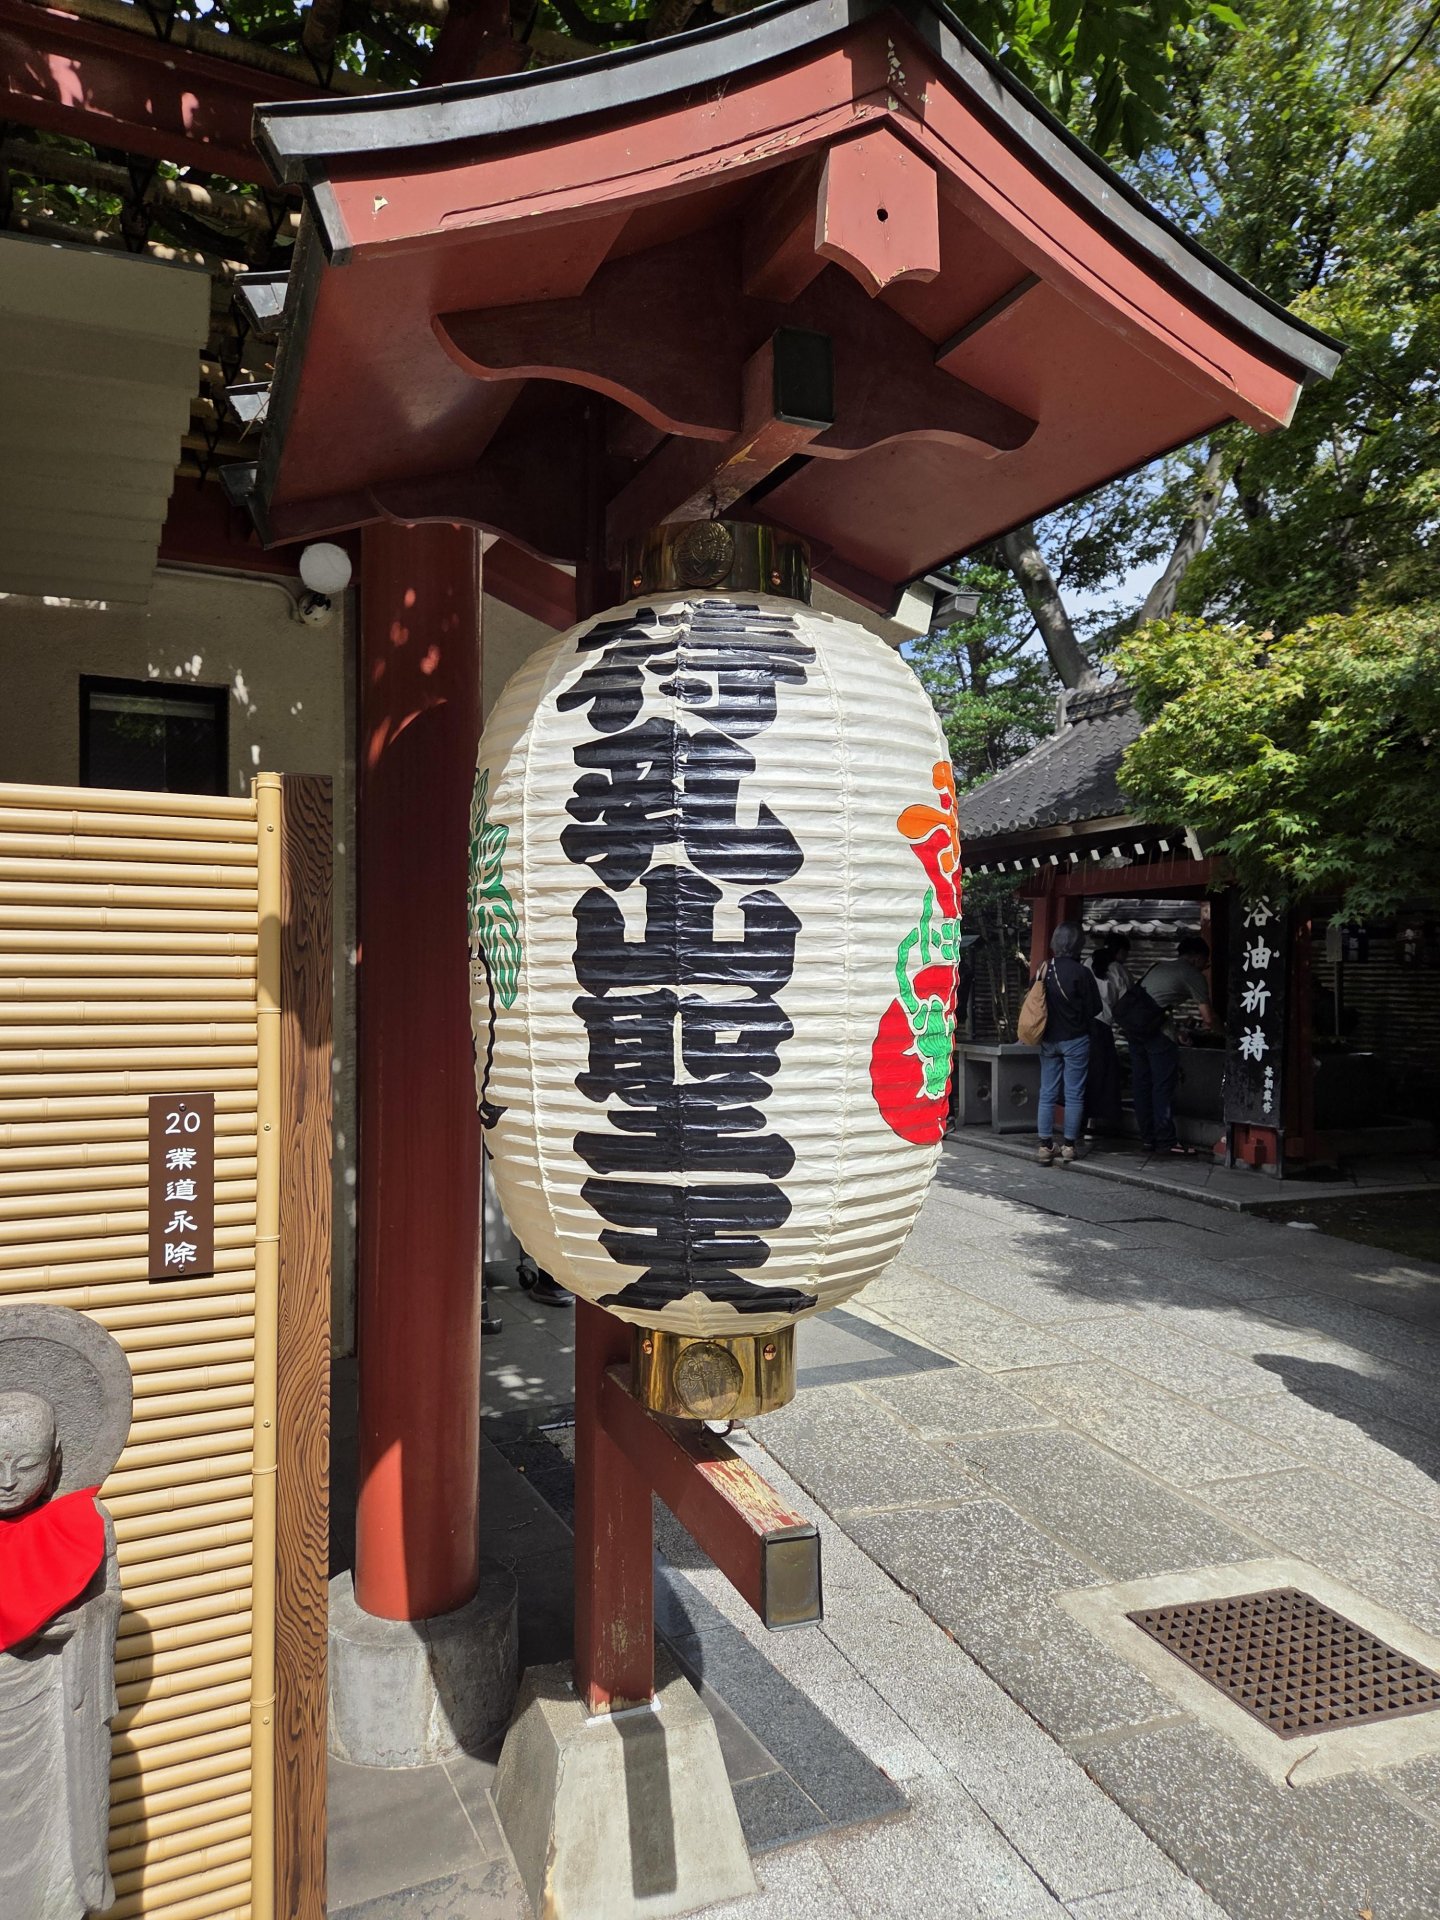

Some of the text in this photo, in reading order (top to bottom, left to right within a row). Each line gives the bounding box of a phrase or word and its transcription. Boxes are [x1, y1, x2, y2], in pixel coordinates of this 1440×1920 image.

[556, 599, 818, 1314] 待乳山聖天
[165, 1112, 201, 1134] 20
[164, 1147, 198, 1266] 業道永除
